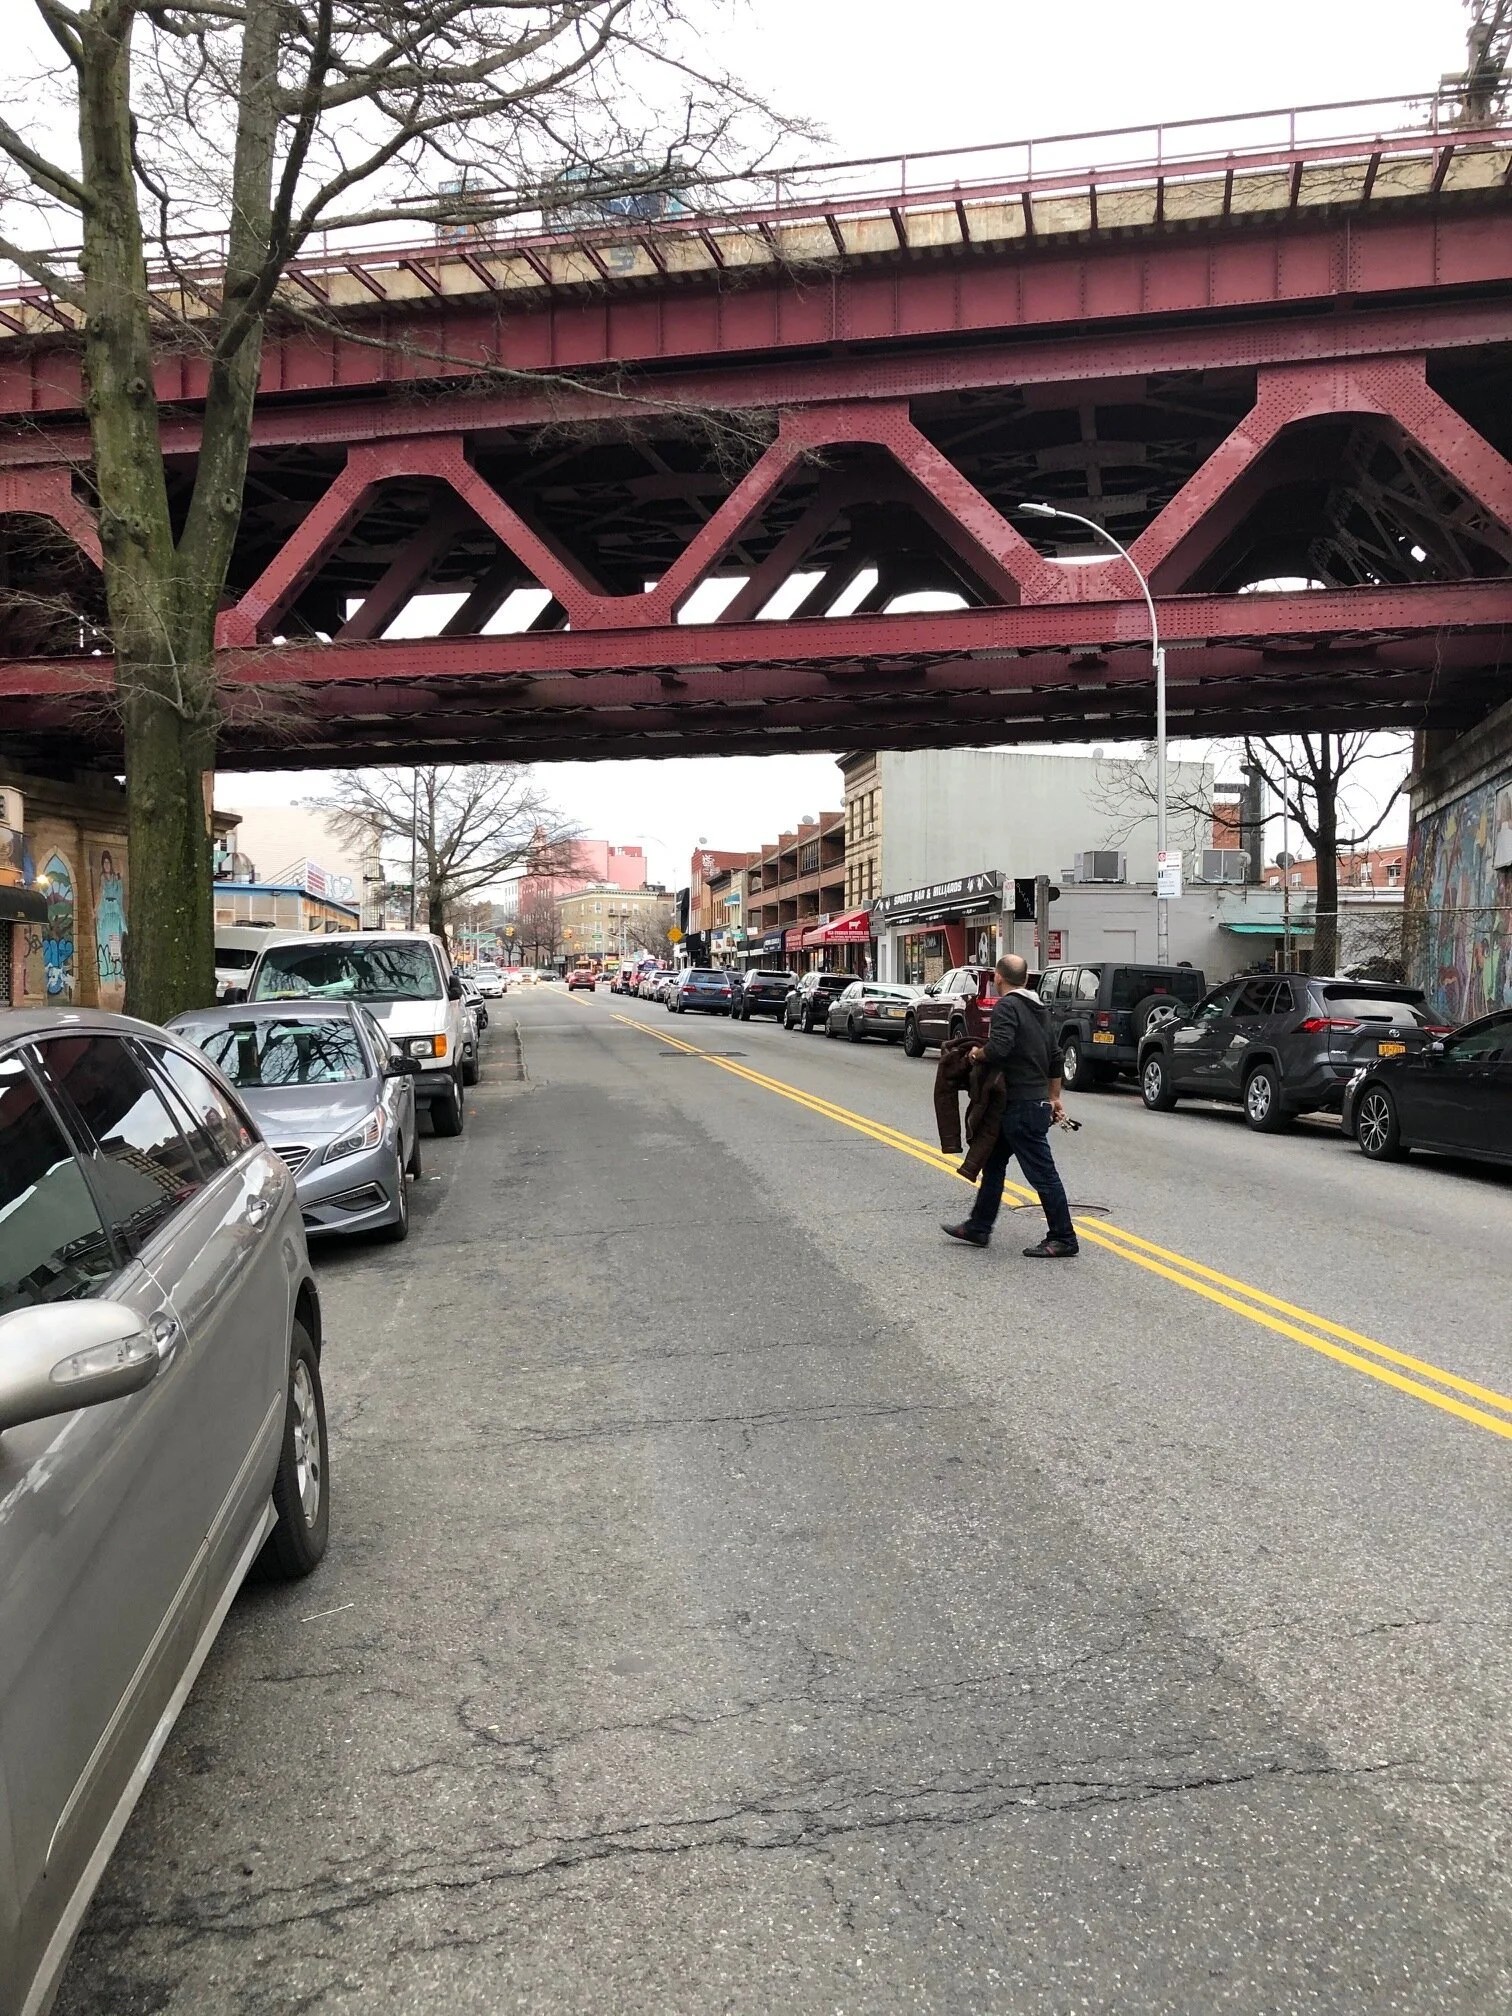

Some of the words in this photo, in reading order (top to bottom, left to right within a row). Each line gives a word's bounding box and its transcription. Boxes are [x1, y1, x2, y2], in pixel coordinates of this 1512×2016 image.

[893, 893, 913, 906] SPORTS
[913, 889, 926, 903] BAR
[926, 888, 931, 899] &
[932, 881, 963, 898] BILLIARDS
